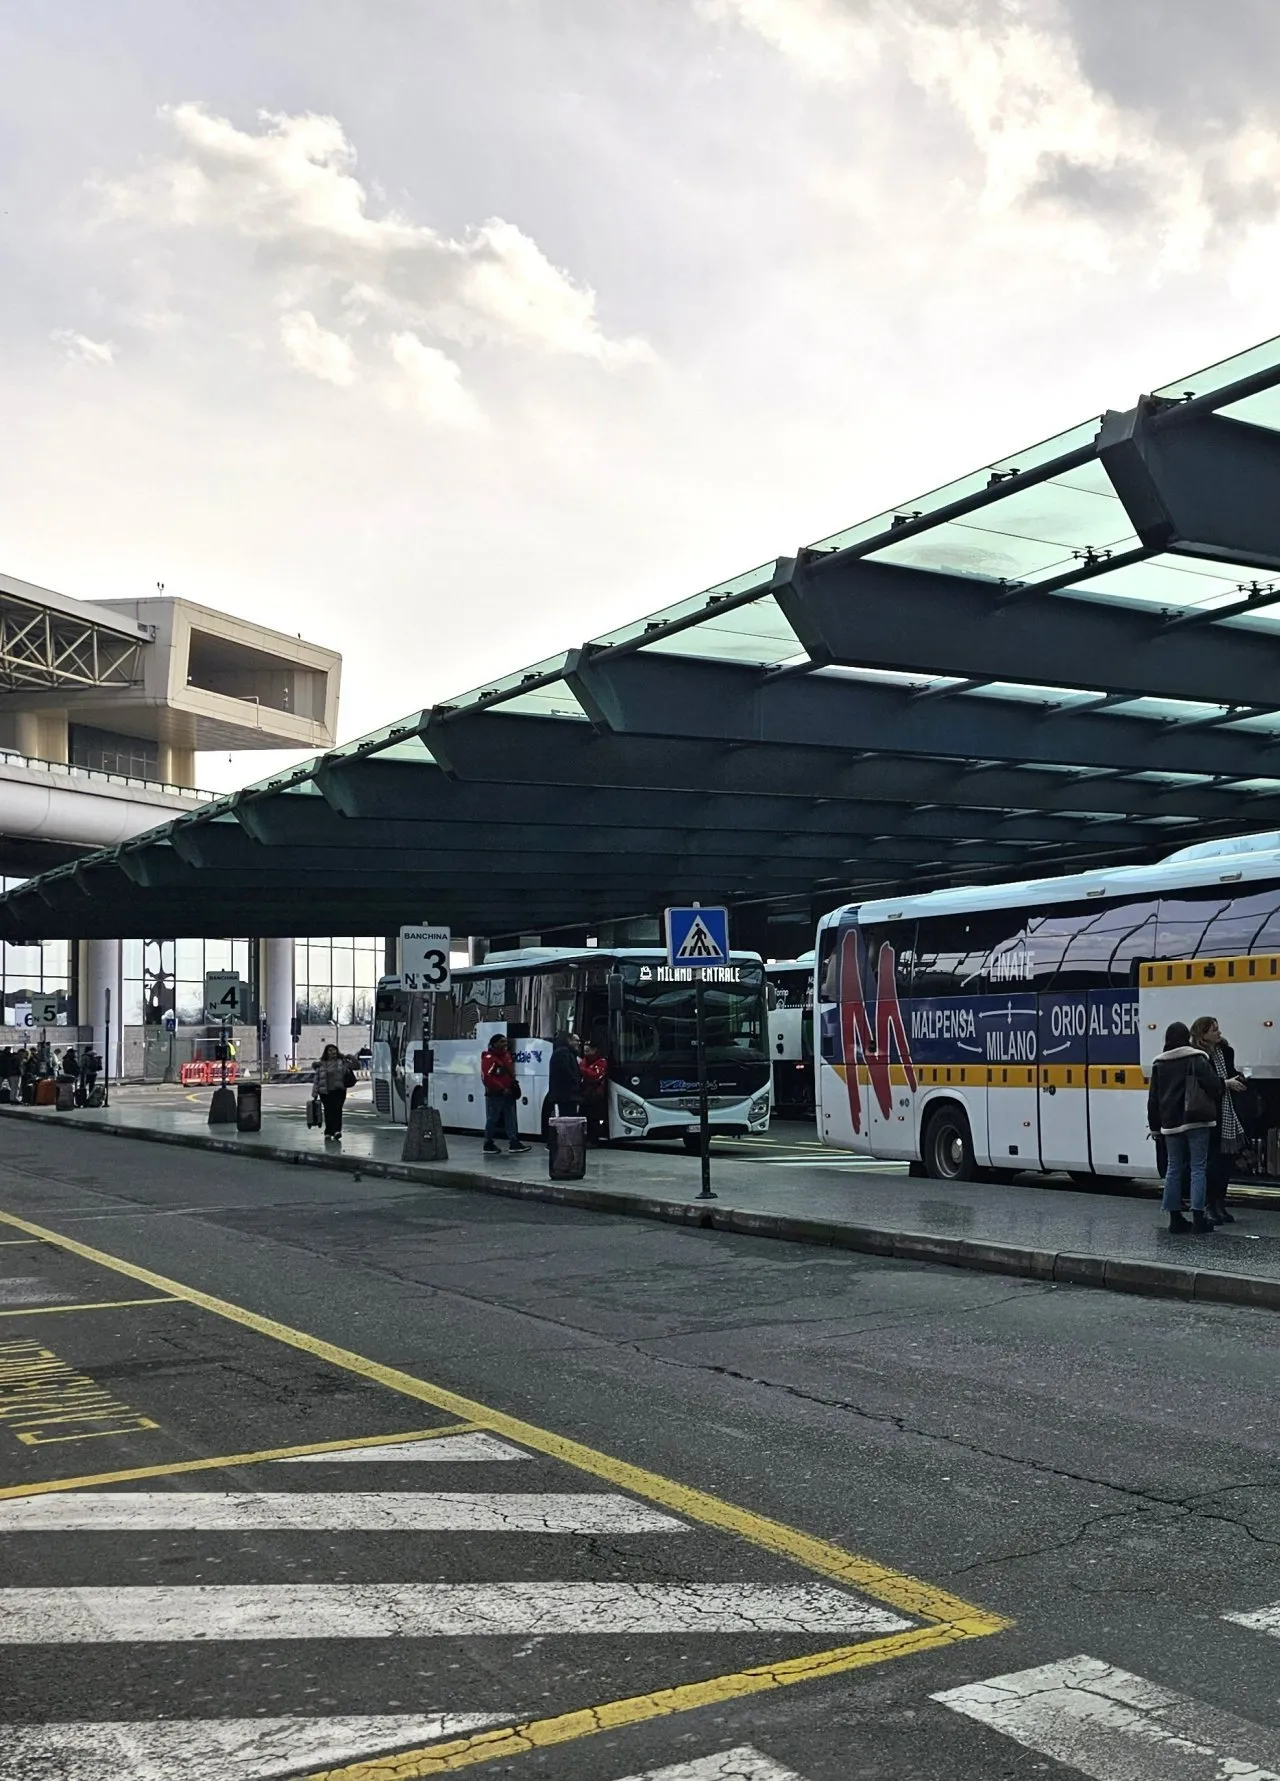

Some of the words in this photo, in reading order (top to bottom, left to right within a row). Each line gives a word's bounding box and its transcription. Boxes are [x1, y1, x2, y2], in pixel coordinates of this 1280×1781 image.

[404, 932, 448, 940] BANCHINA
[423, 949, 448, 985] 3
[657, 966, 693, 982] MILANO
[701, 967, 741, 983] ENTRALE
[989, 950, 1036, 983] LINATE
[220, 986, 239, 1010] 4
[24, 1012, 34, 1027] 6
[43, 1004, 57, 1022] 5
[911, 1009, 976, 1039] MALPENSA
[1051, 1003, 1086, 1037] ORIO
[1089, 1003, 1109, 1036] AL
[986, 1030, 1037, 1061] MILANO
